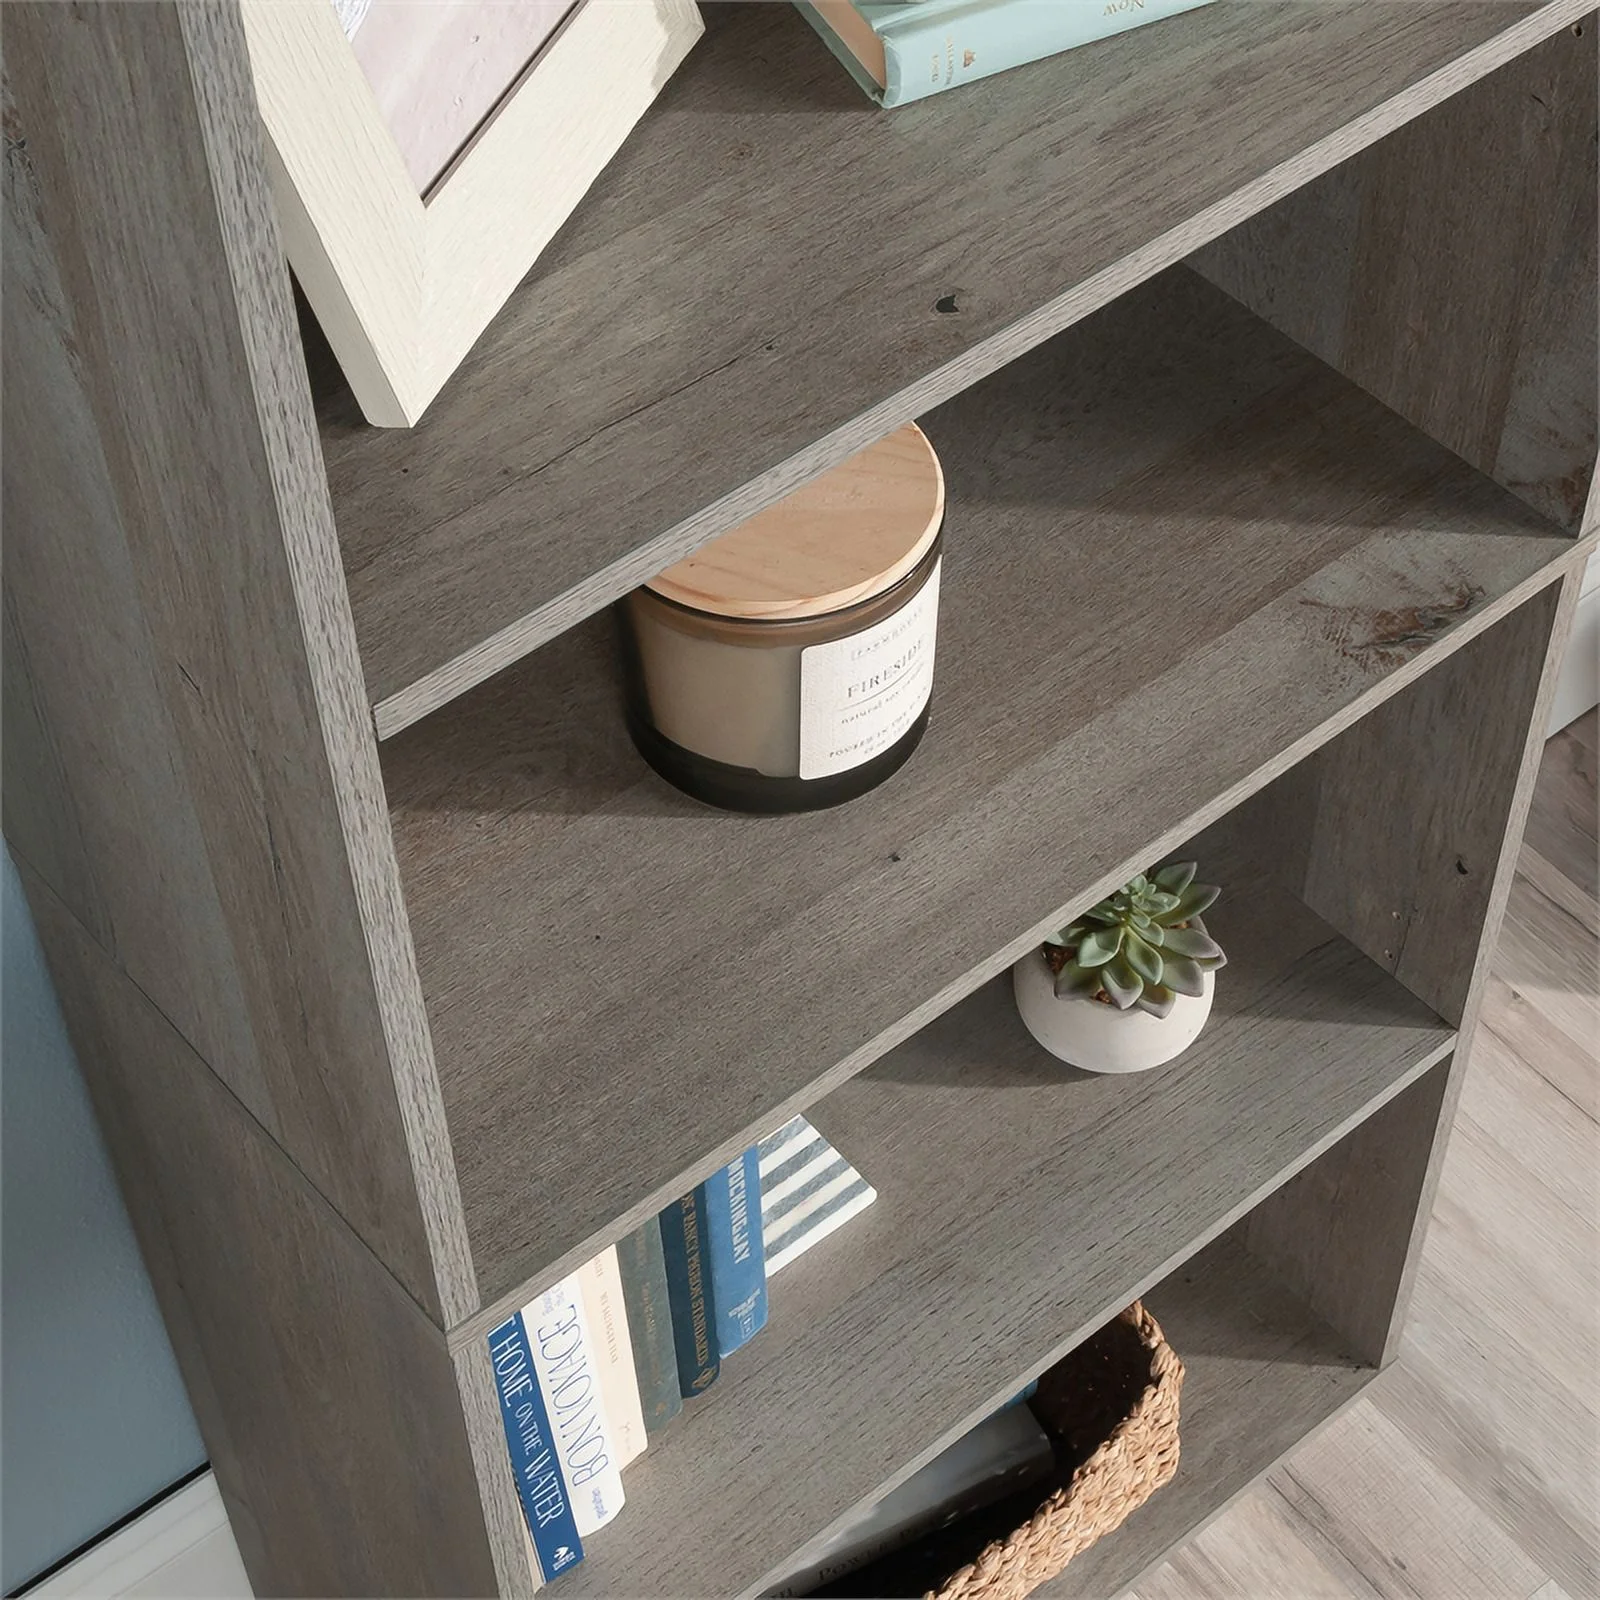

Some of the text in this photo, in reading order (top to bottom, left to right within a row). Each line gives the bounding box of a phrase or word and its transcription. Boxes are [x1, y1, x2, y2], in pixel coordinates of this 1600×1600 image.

[727, 1155, 750, 1265] MOCKINGJAY
[491, 1331, 533, 1408] HOME
[537, 1304, 595, 1429] VOYAGE
[514, 1402, 534, 1429] ON
[520, 1421, 543, 1456] THE
[562, 1413, 609, 1487] BON
[524, 1448, 565, 1529] WATER
